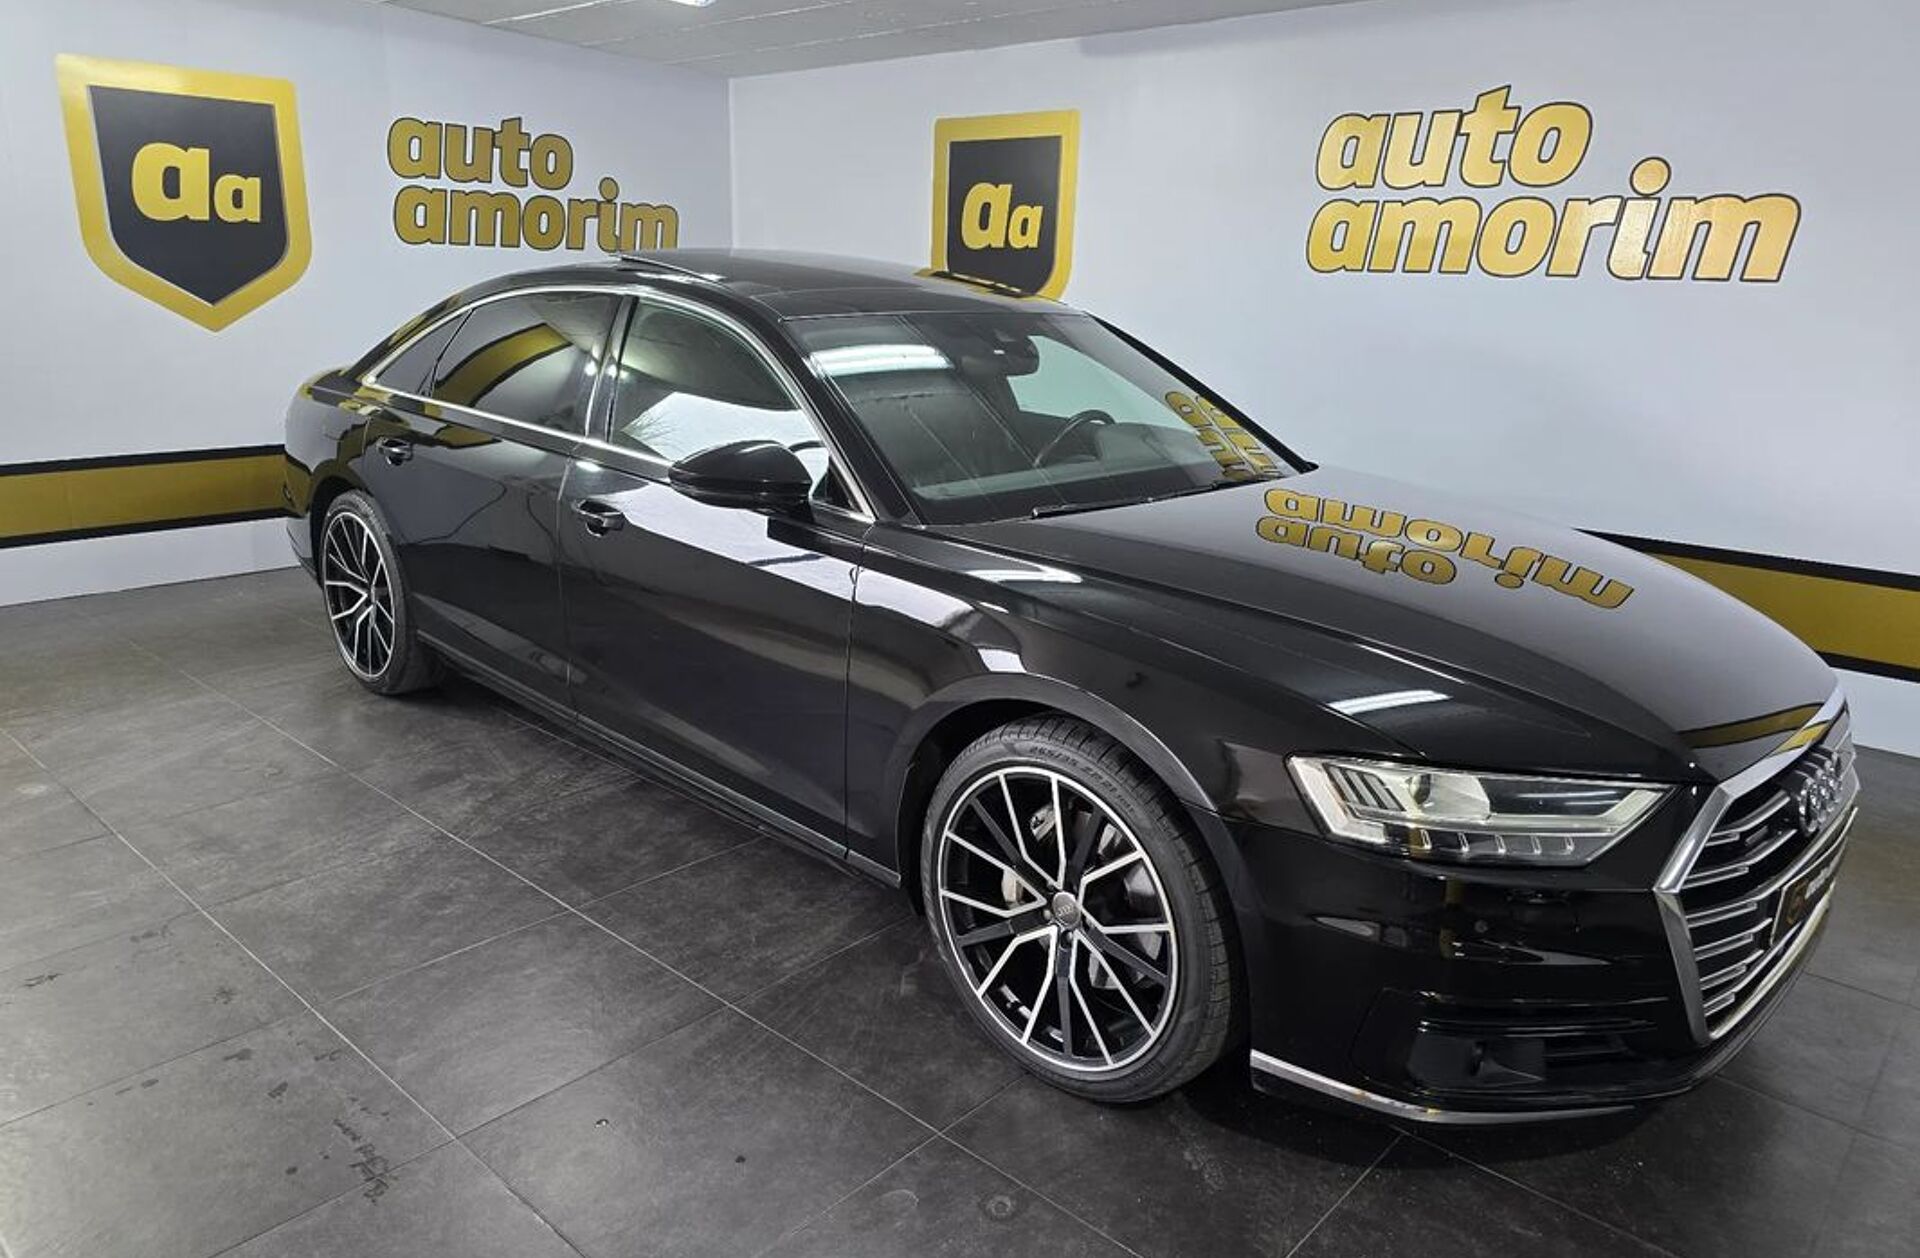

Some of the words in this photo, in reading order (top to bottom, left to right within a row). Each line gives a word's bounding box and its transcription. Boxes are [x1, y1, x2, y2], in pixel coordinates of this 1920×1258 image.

[387, 116, 574, 190] auto
[1315, 85, 1593, 190] auto
[132, 142, 261, 223] aa
[394, 177, 678, 252] amorim
[961, 182, 1043, 249] aa
[1306, 157, 1801, 282] amorim
